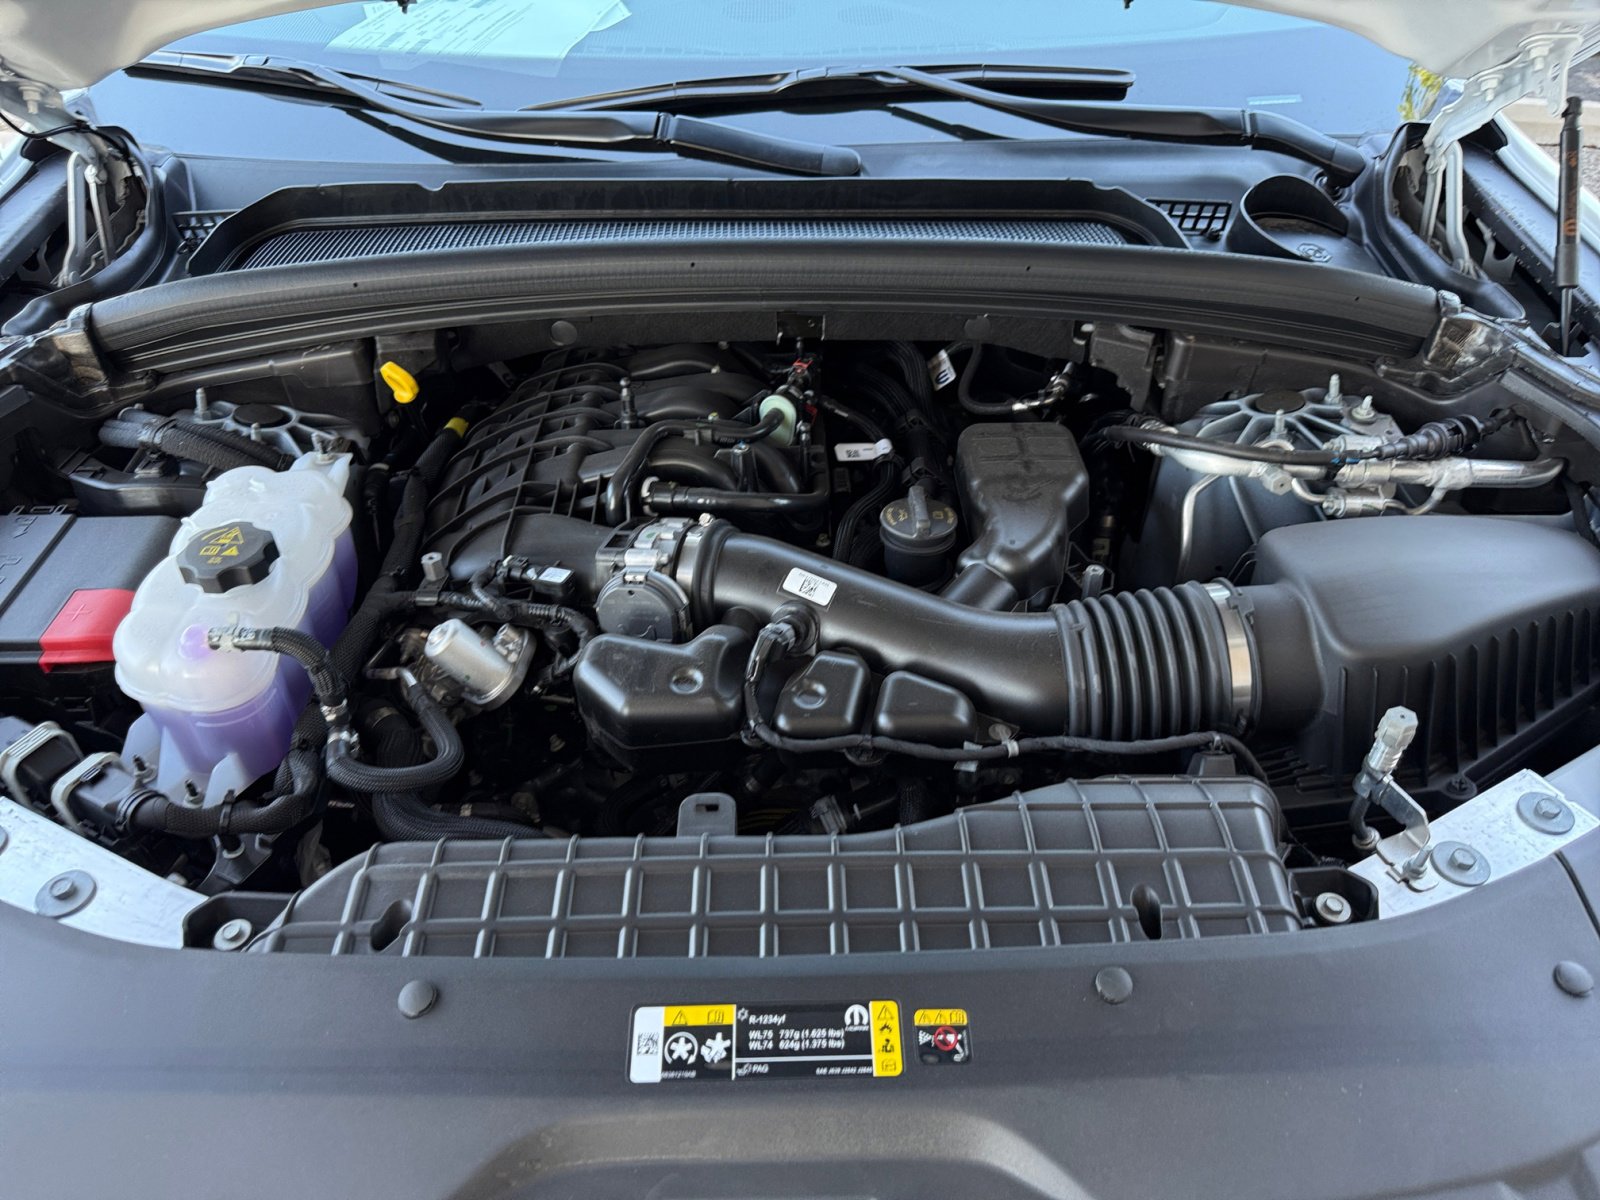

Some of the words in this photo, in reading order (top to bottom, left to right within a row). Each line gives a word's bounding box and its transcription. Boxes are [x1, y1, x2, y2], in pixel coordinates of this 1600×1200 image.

[748, 1029, 774, 1040] WL75
[779, 1029, 801, 1040] 737g
[828, 1028, 845, 1039] lbs)
[748, 1040, 774, 1050] WL74
[779, 1039, 801, 1051] 624g
[828, 1038, 845, 1050] lbs)
